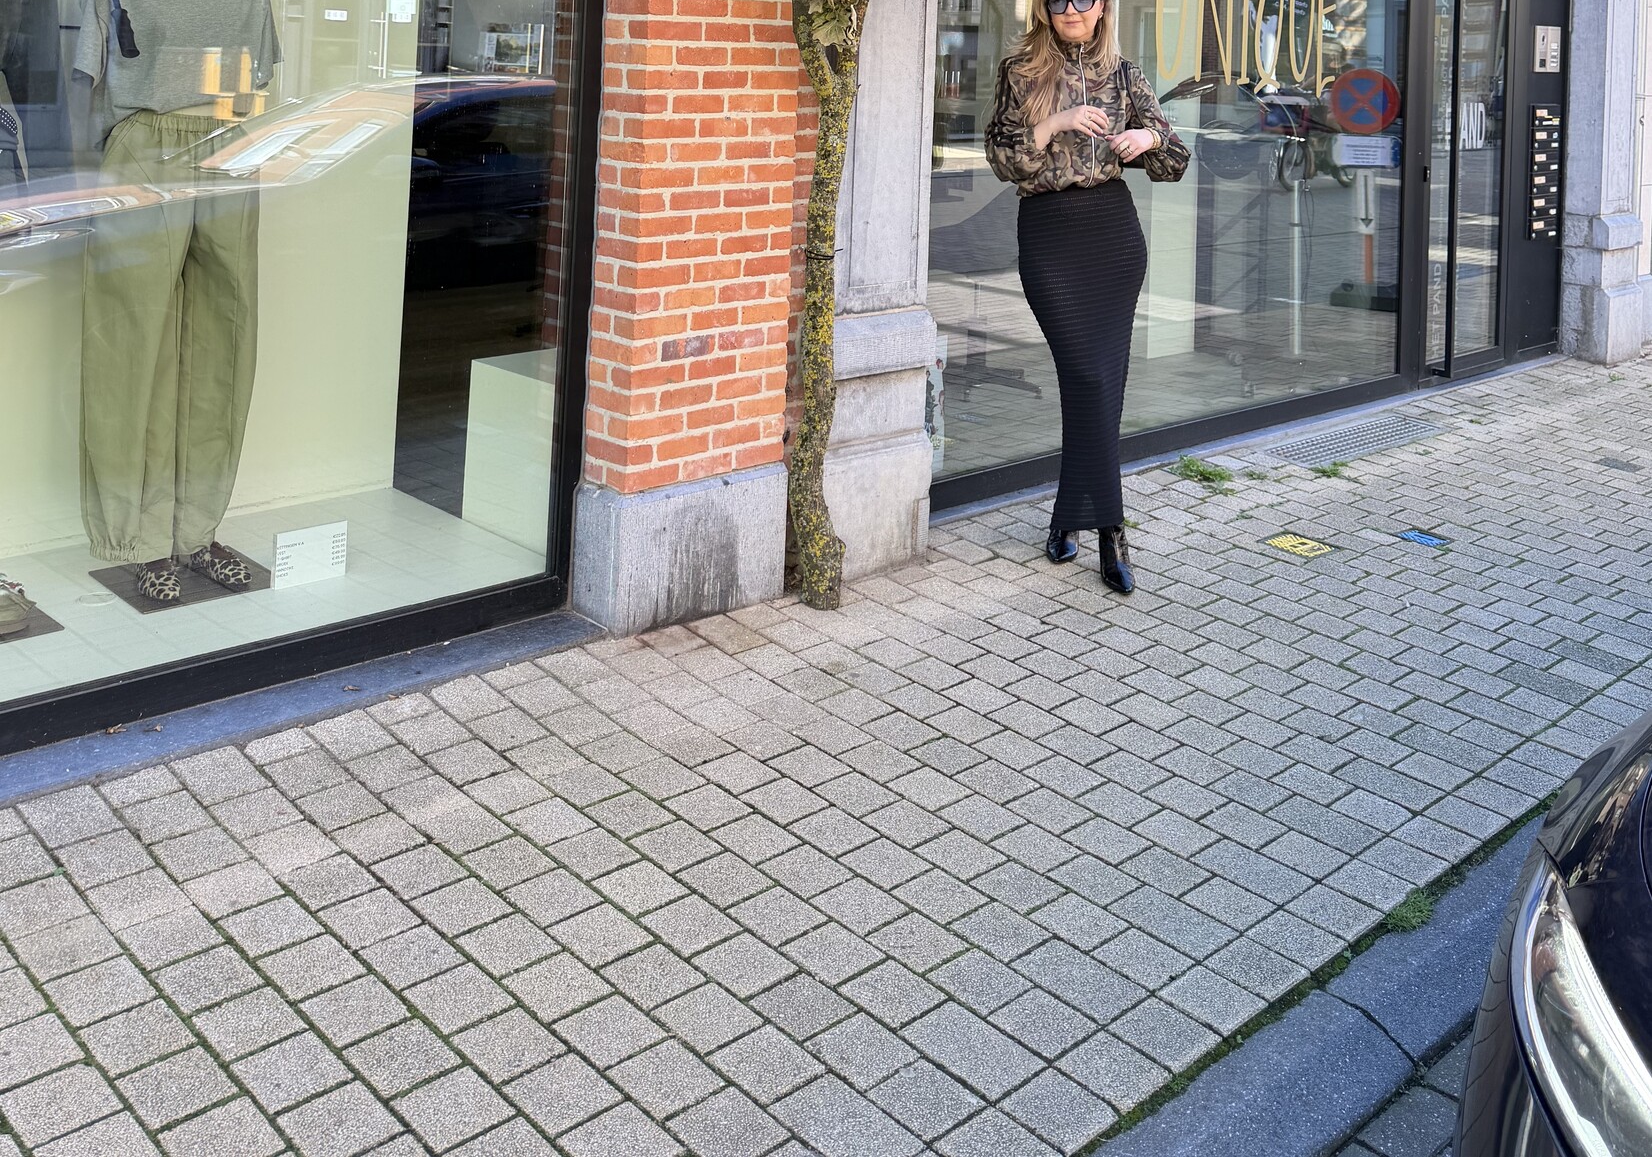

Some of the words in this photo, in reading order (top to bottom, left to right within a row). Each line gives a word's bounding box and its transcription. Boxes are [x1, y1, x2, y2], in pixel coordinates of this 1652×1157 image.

[1439, 27, 1449, 62] HET
[1459, 102, 1486, 150] AND
[1432, 263, 1442, 315] PAND
